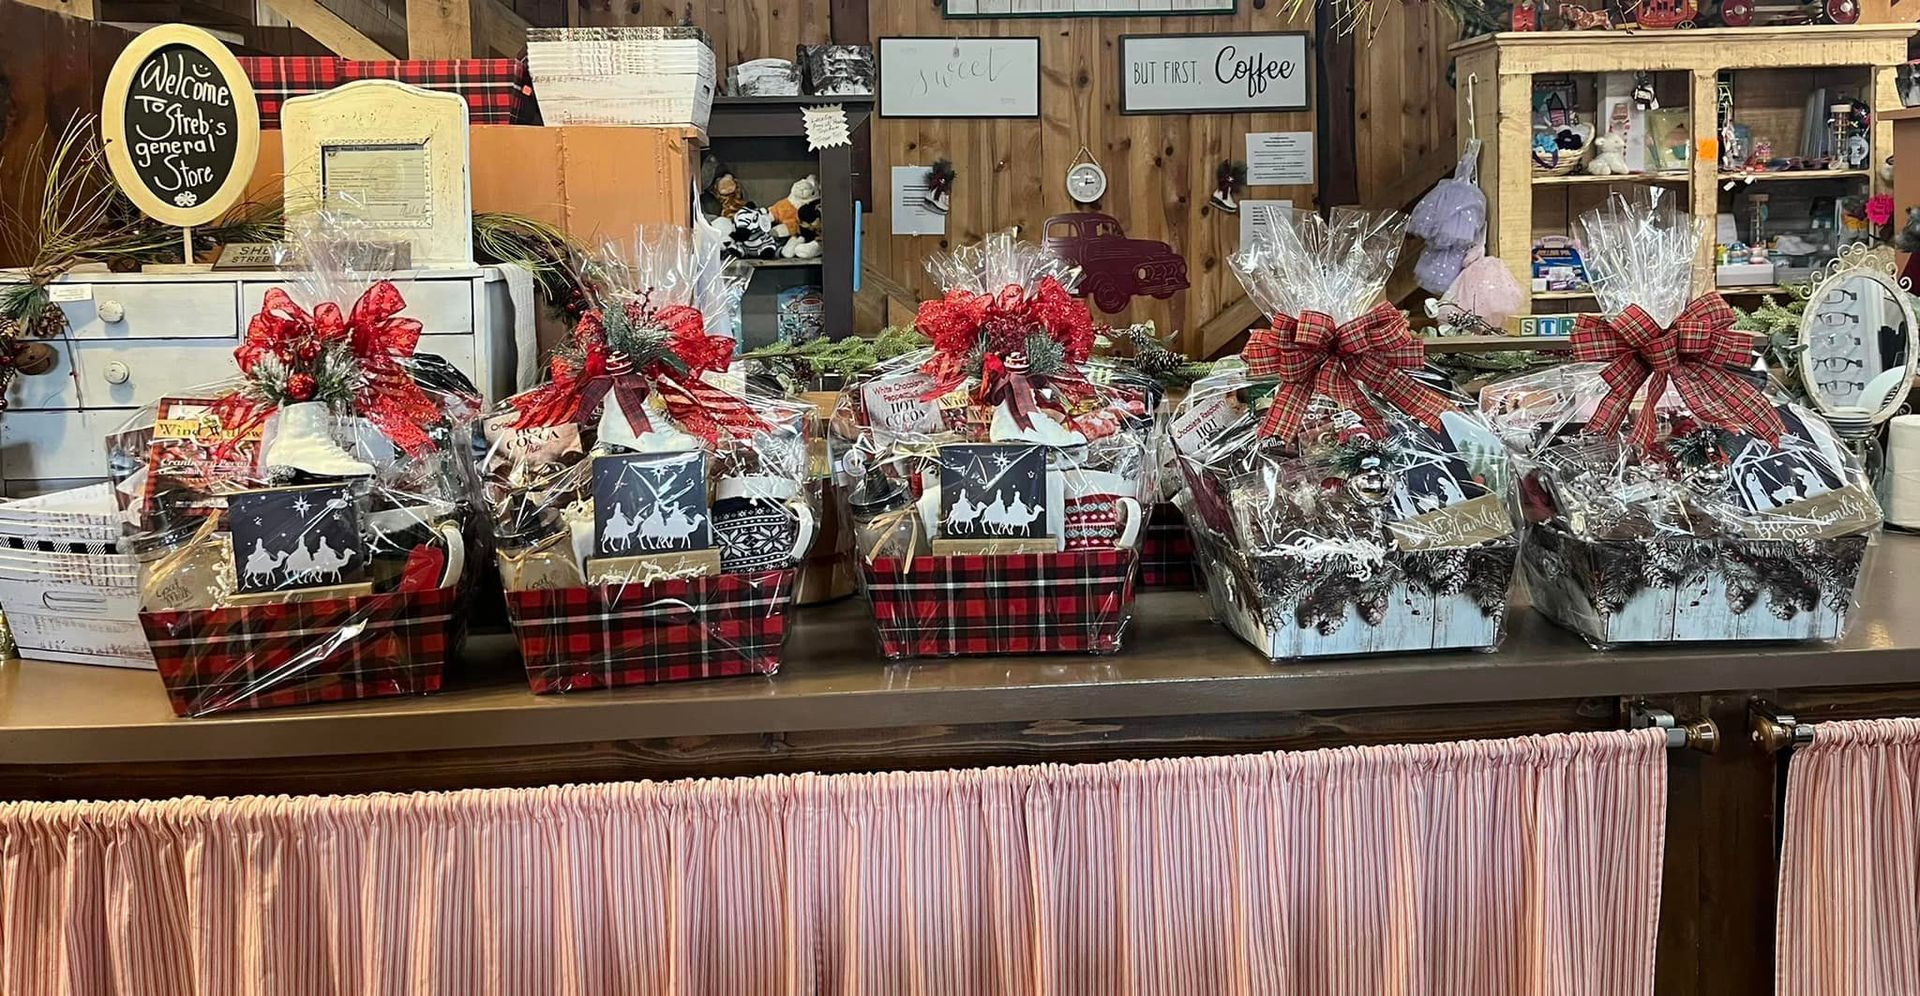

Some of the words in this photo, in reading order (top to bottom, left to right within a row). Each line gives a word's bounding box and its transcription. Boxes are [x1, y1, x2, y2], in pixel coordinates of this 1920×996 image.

[140, 52, 230, 106] Welcome
[1133, 62, 1157, 85] BUT
[1214, 45, 1296, 98] Coffee
[135, 103, 227, 141] Streb's
[135, 134, 216, 167] general
[153, 155, 214, 191] Store
[890, 399, 916, 414] HOT
[1196, 417, 1218, 439] HOT
[1782, 525, 1810, 542] Our
